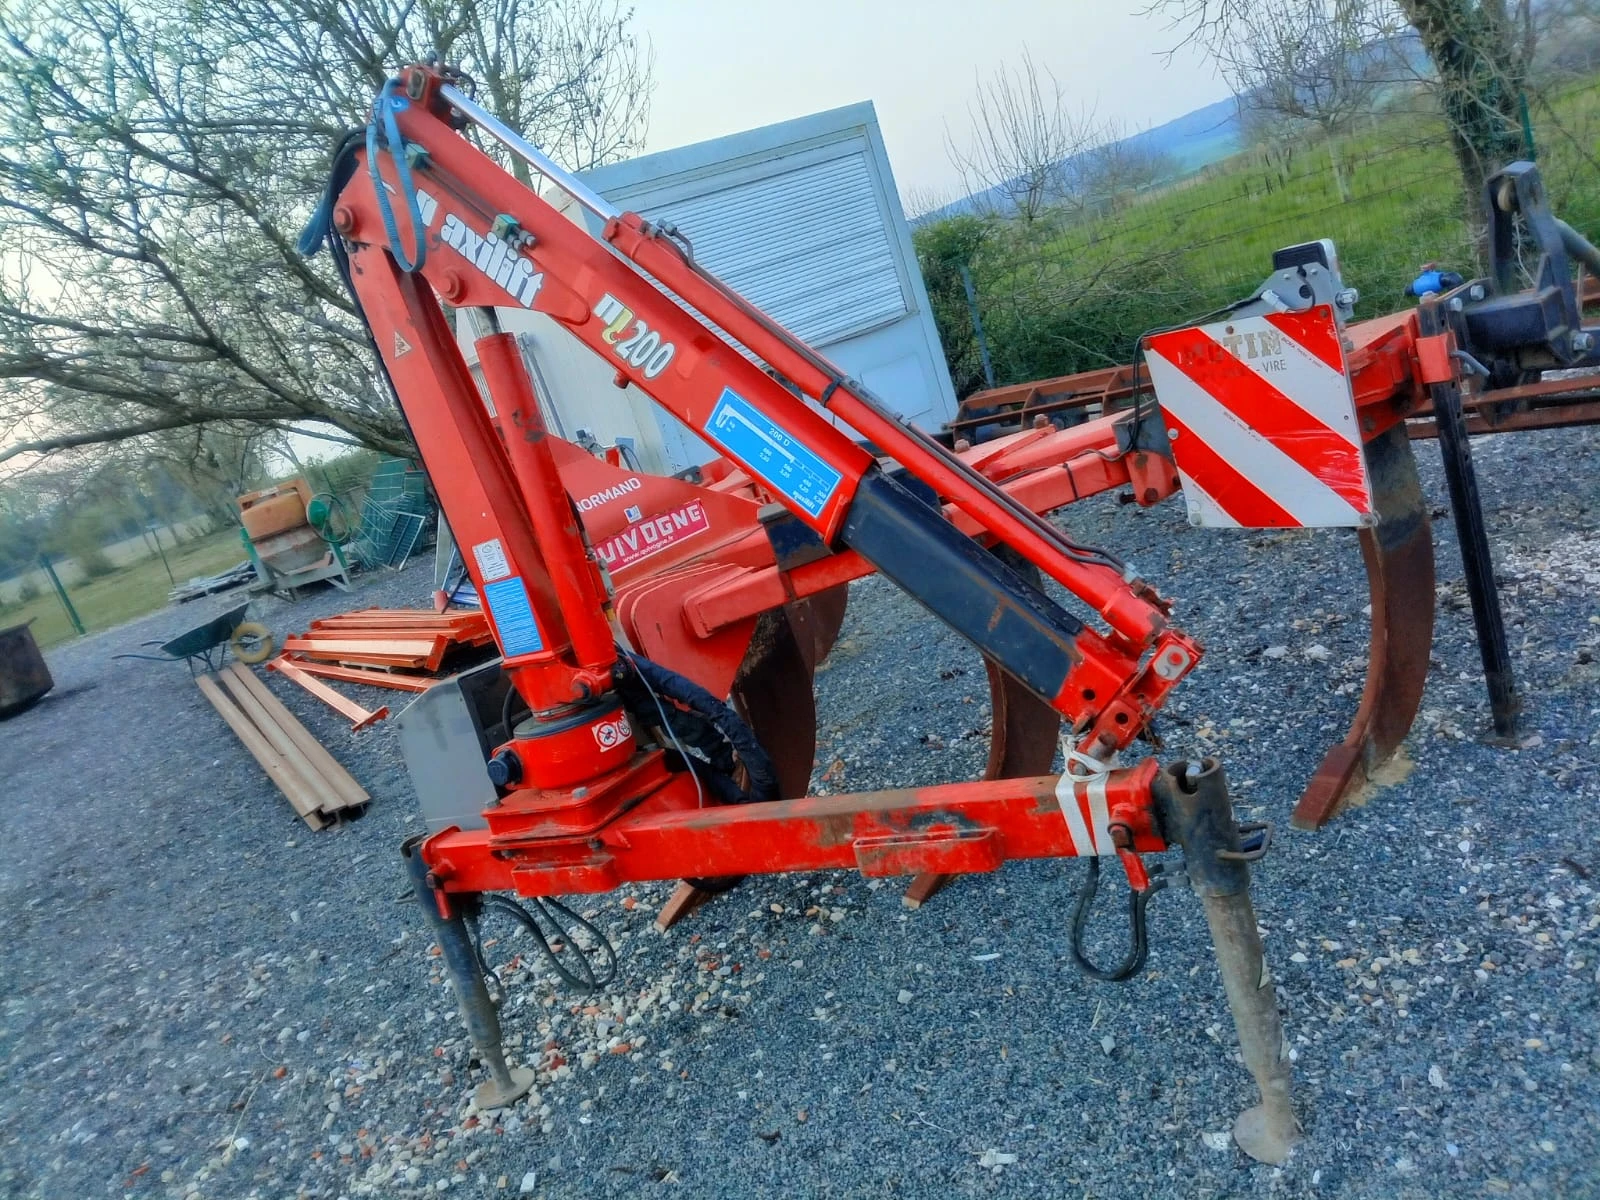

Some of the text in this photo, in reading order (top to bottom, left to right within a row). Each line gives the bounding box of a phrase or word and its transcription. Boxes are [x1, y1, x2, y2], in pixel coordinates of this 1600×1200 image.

[1263, 359, 1288, 373] VIRE
[769, 427, 783, 441] 200
[576, 477, 641, 513] NORMAND
